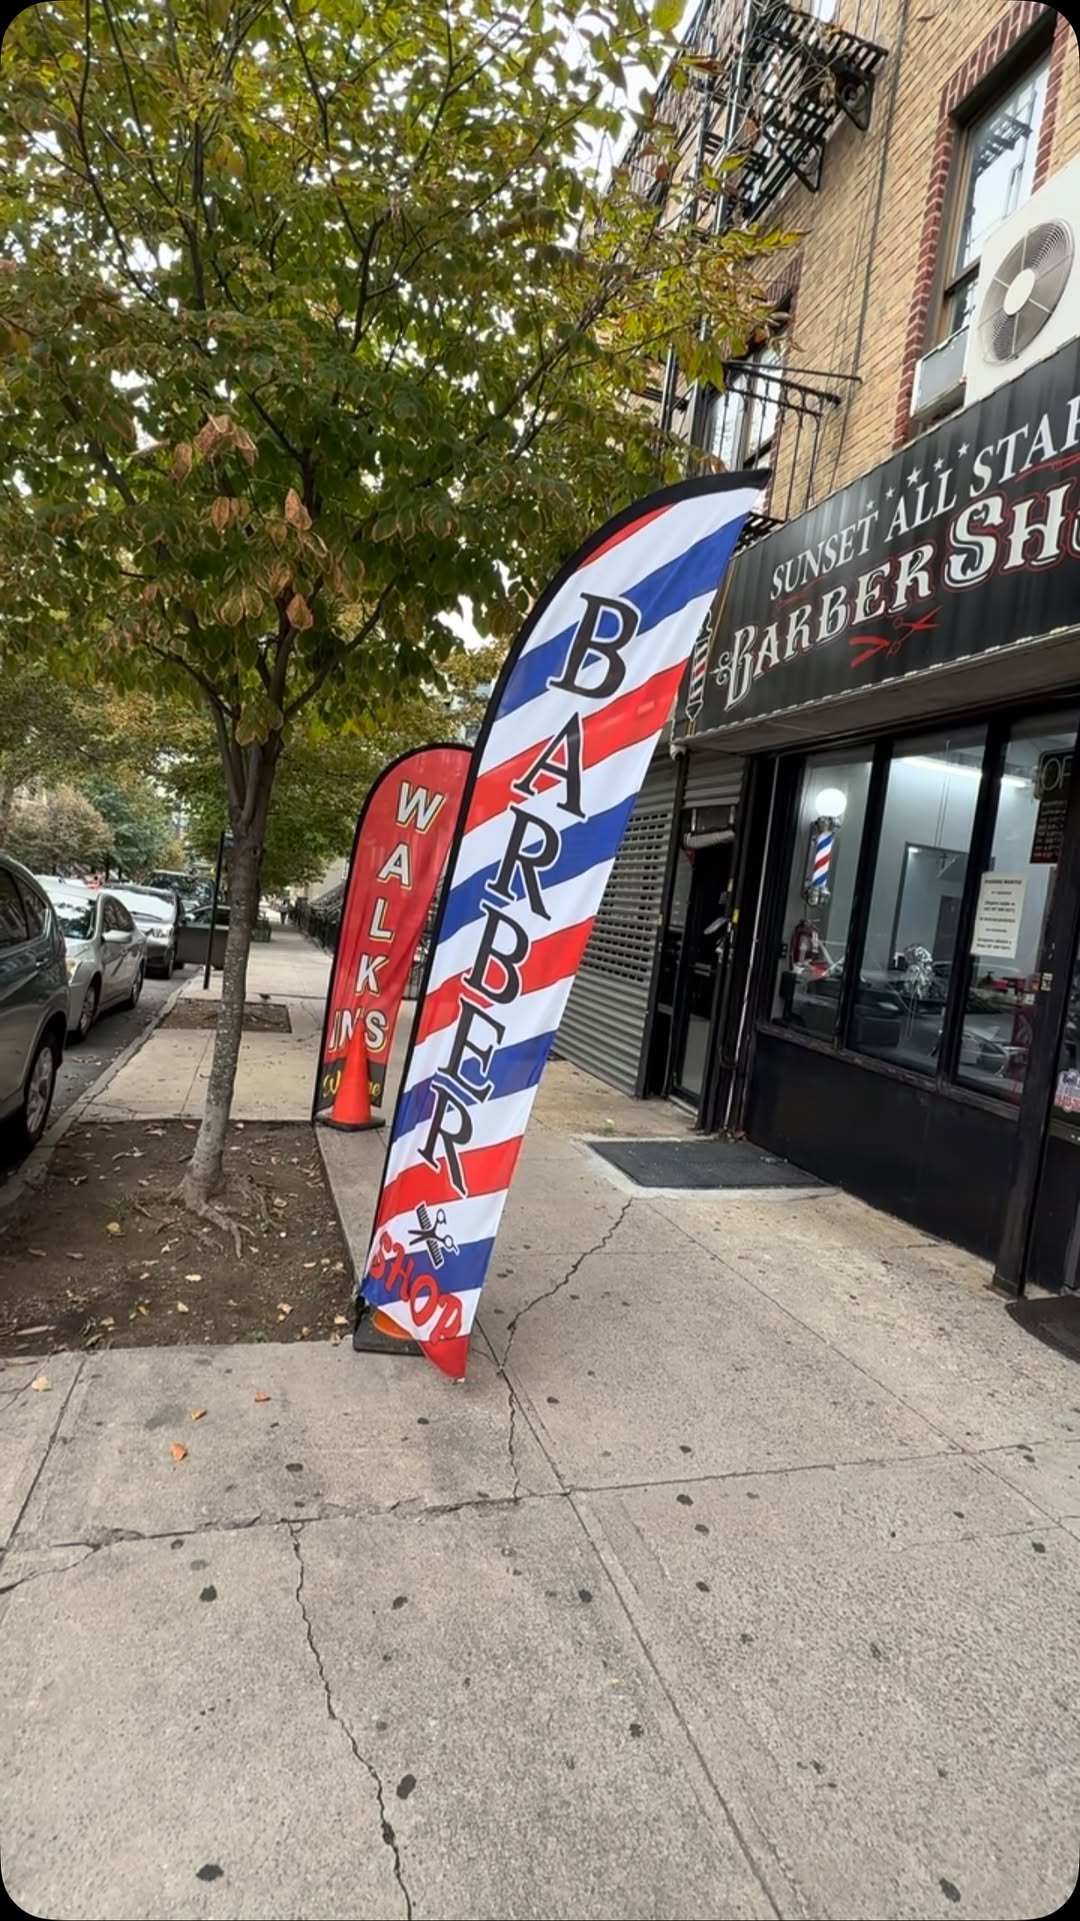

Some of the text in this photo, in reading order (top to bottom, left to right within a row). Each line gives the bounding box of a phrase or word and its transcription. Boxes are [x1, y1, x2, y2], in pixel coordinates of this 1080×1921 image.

[710, 483, 1080, 711] BARBER SH
[770, 511, 878, 600] SUNSET
[884, 468, 957, 543] ALL
[354, 781, 445, 996] WALK
[417, 592, 640, 1196] BARBER
[369, 1232, 463, 1344] SHOP
